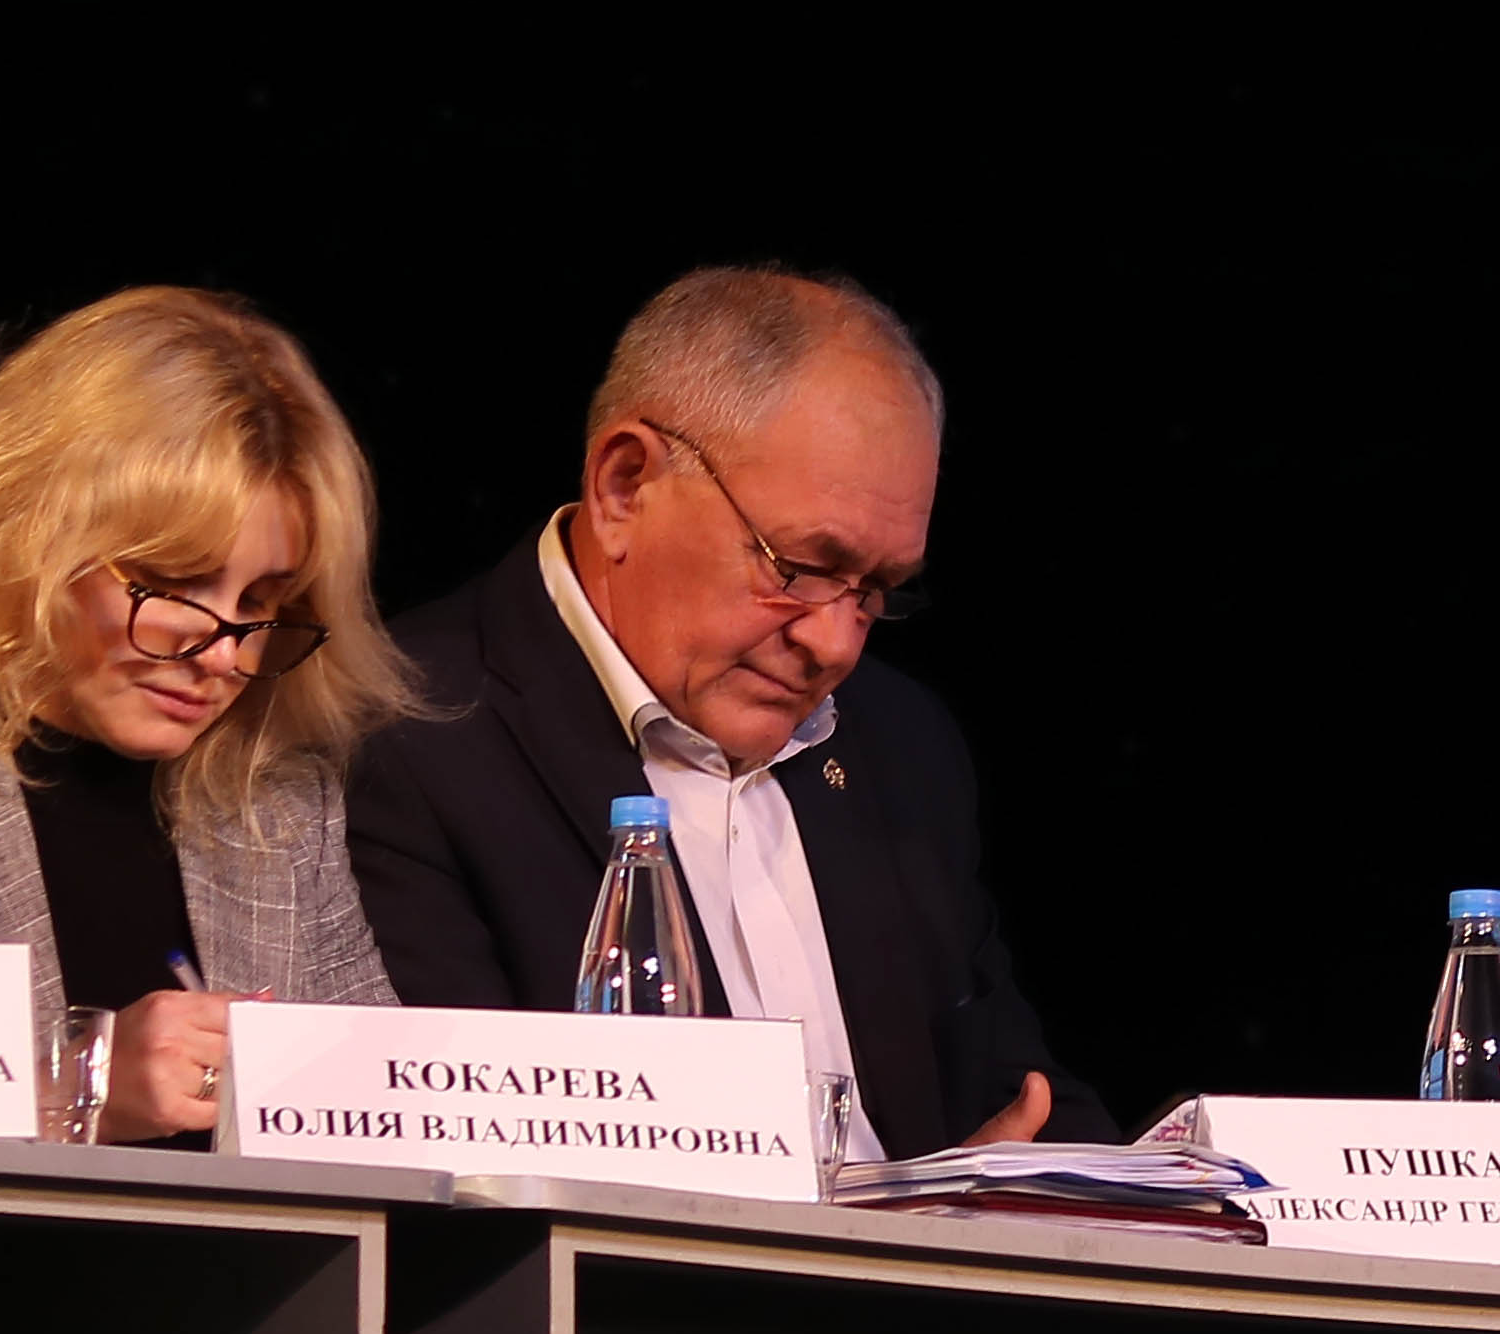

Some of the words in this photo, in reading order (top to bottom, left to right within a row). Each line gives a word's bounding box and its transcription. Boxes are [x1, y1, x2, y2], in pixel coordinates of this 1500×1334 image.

[383, 1058, 658, 1102] КОКАРЕВА
[257, 1106, 403, 1140] ЮЛИЯ
[420, 1113, 794, 1158] ВЛАДИМИРОВНА
